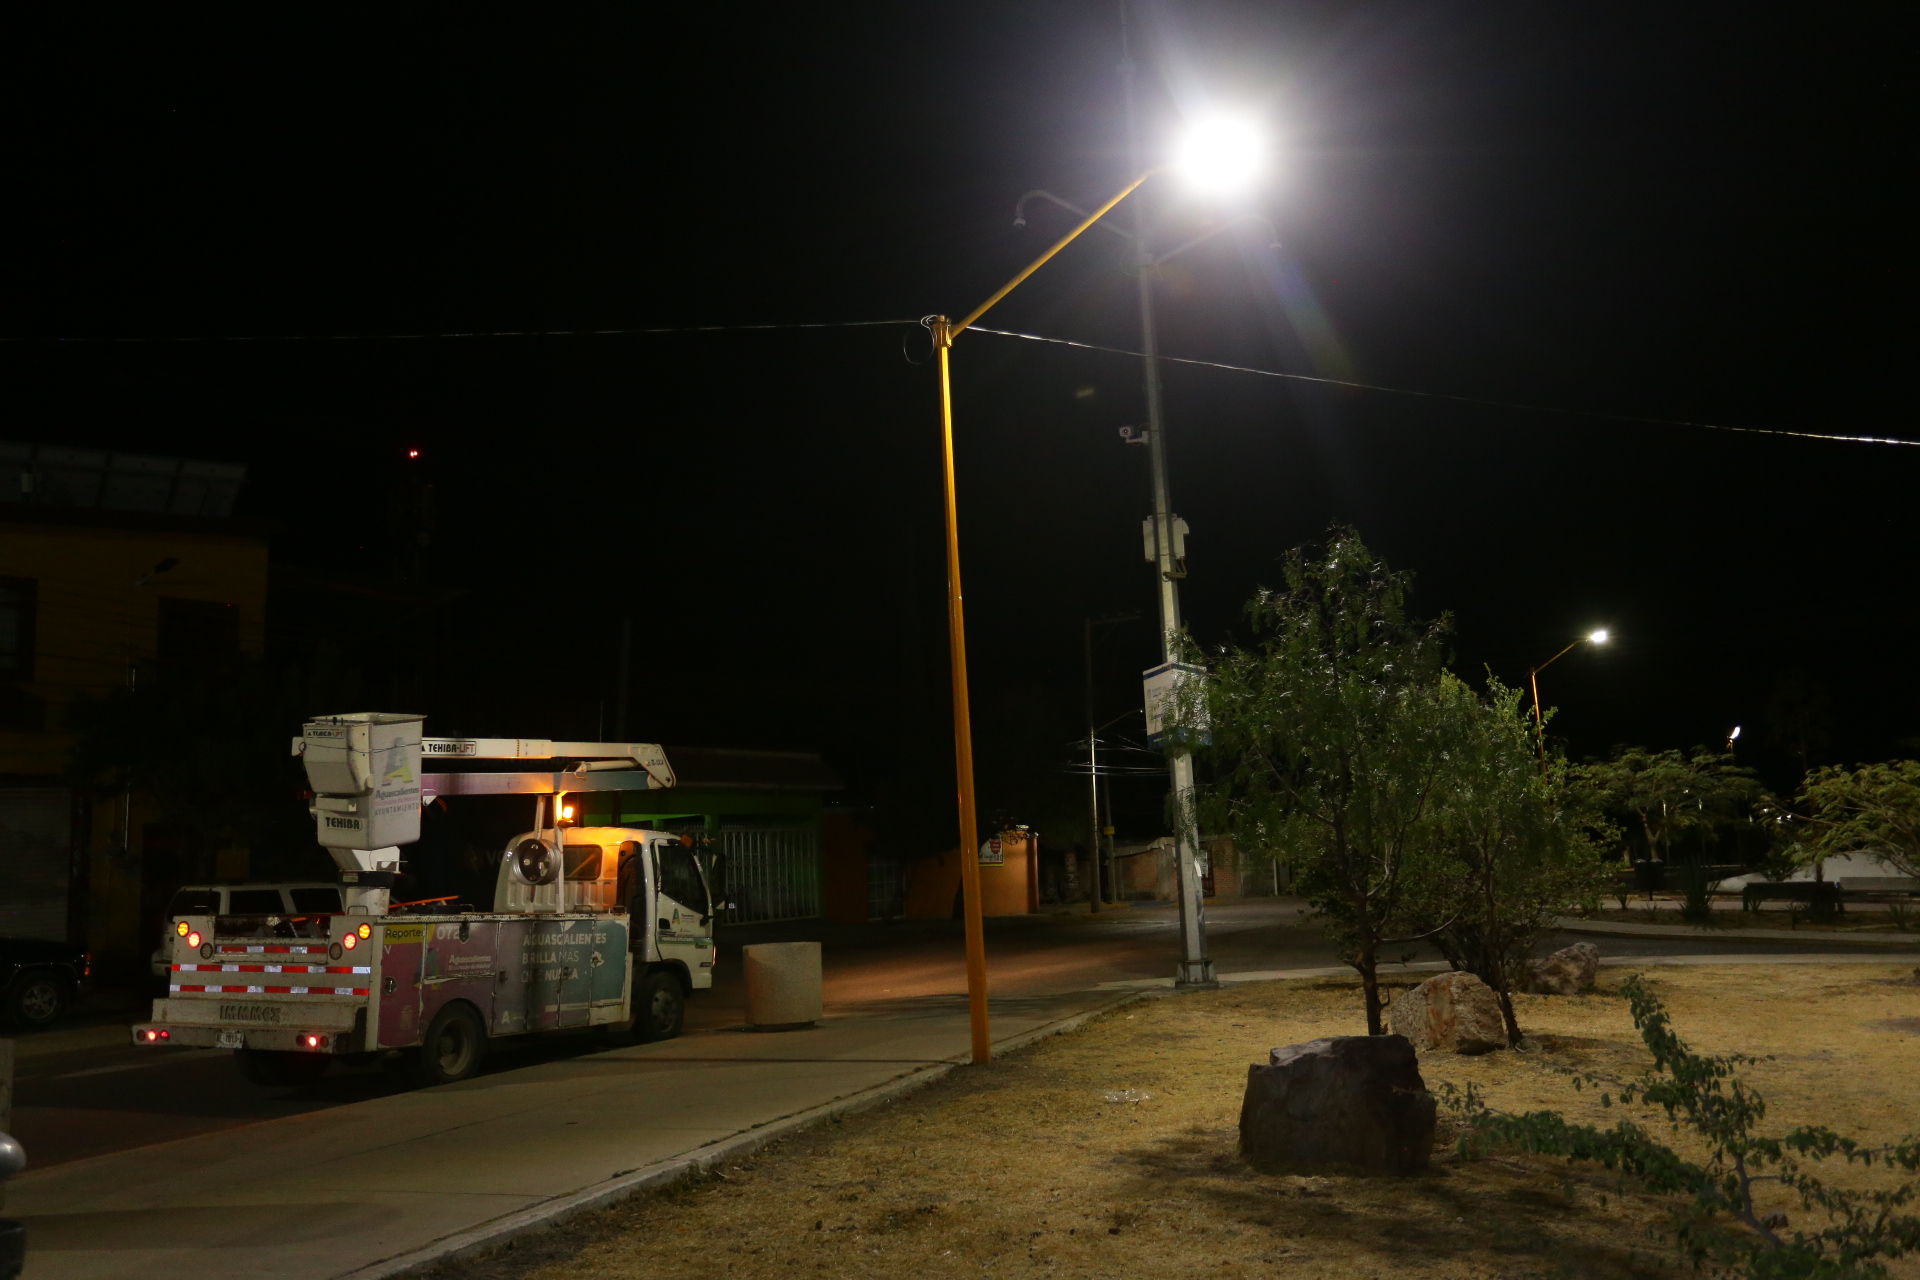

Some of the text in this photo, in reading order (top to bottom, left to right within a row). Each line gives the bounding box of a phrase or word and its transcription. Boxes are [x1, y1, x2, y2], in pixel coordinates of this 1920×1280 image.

[428, 743, 475, 753] TEHIBA-LIFT
[375, 787, 420, 800] Aguascalientes
[325, 817, 360, 830] TEHIBA
[523, 933, 607, 946] AGUASCALIENES
[522, 952, 557, 964] BRILLA
[545, 968, 578, 981] NUA
